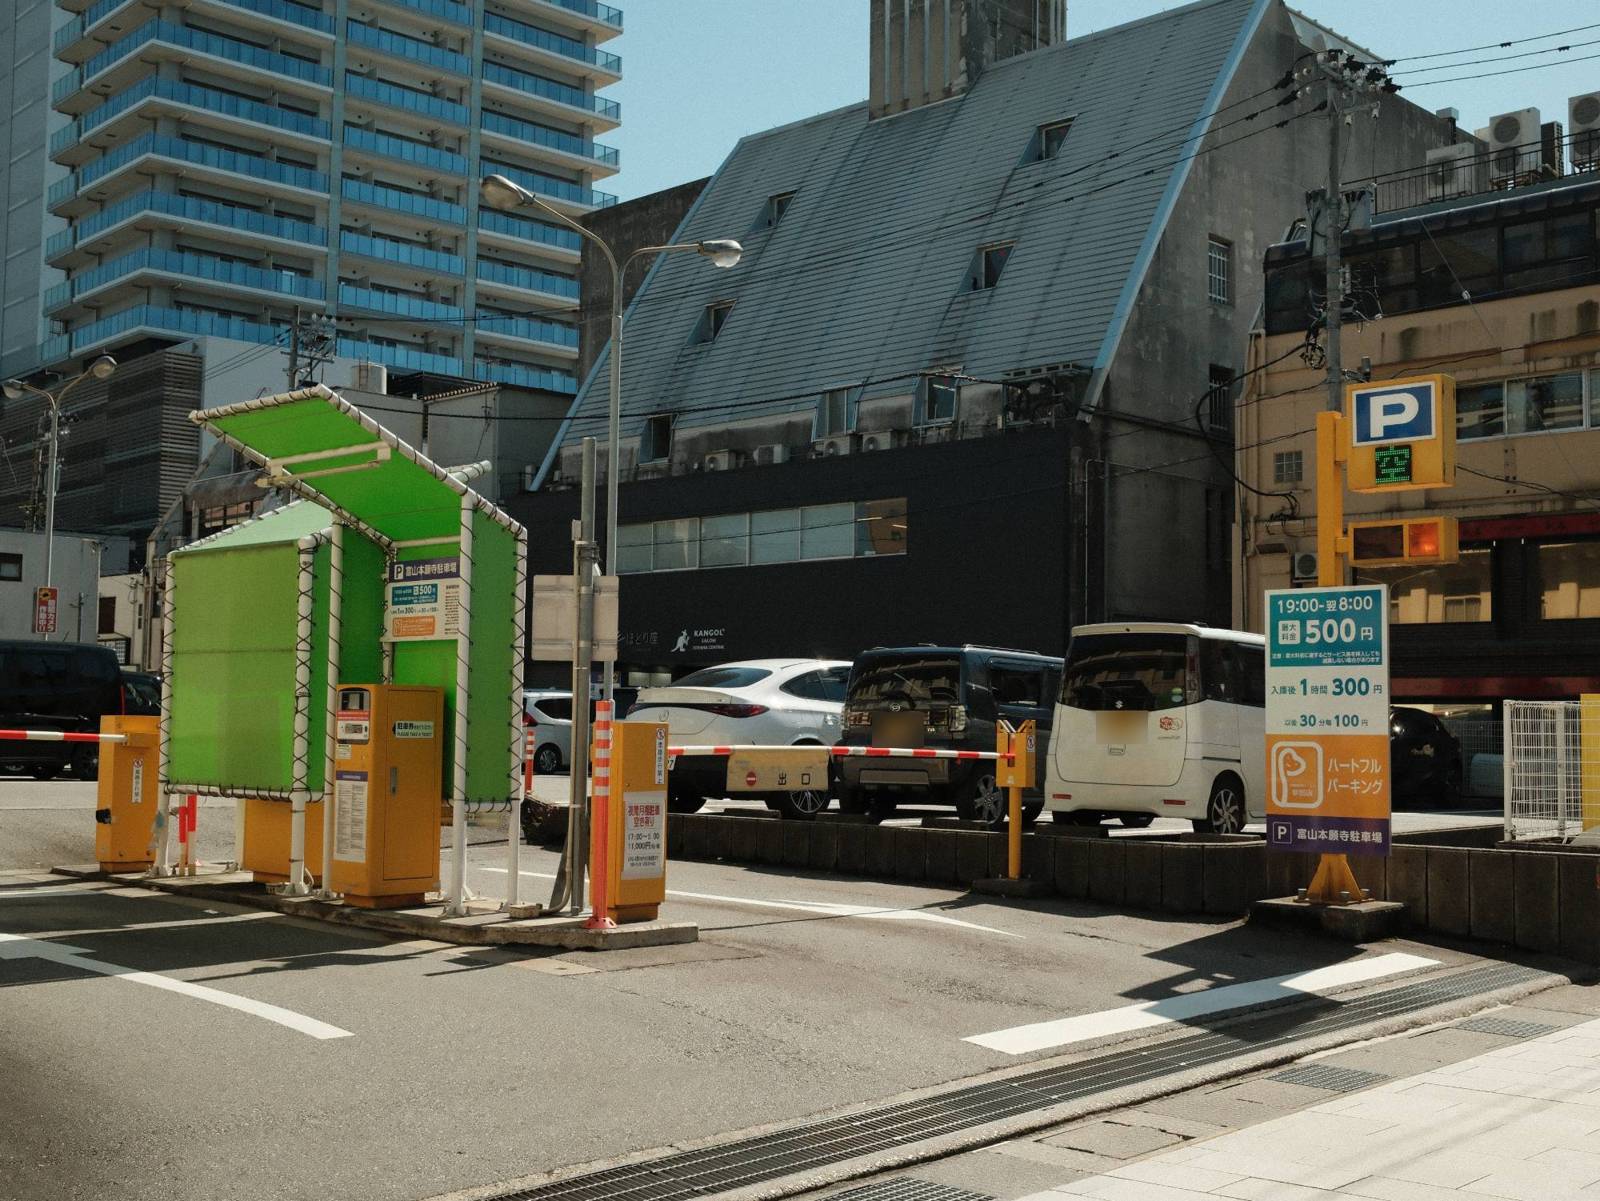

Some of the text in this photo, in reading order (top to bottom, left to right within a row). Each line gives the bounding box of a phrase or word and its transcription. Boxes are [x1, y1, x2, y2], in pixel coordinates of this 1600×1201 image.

[1370, 392, 1419, 438] P
[395, 564, 403, 579] P
[693, 628, 724, 637] KANGOL
[1328, 758, 1381, 774] ハートフル
[1328, 779, 1383, 795] パーキング
[1277, 825, 1287, 840] P
[1297, 828, 1383, 844] 富山本願寺駐車場
